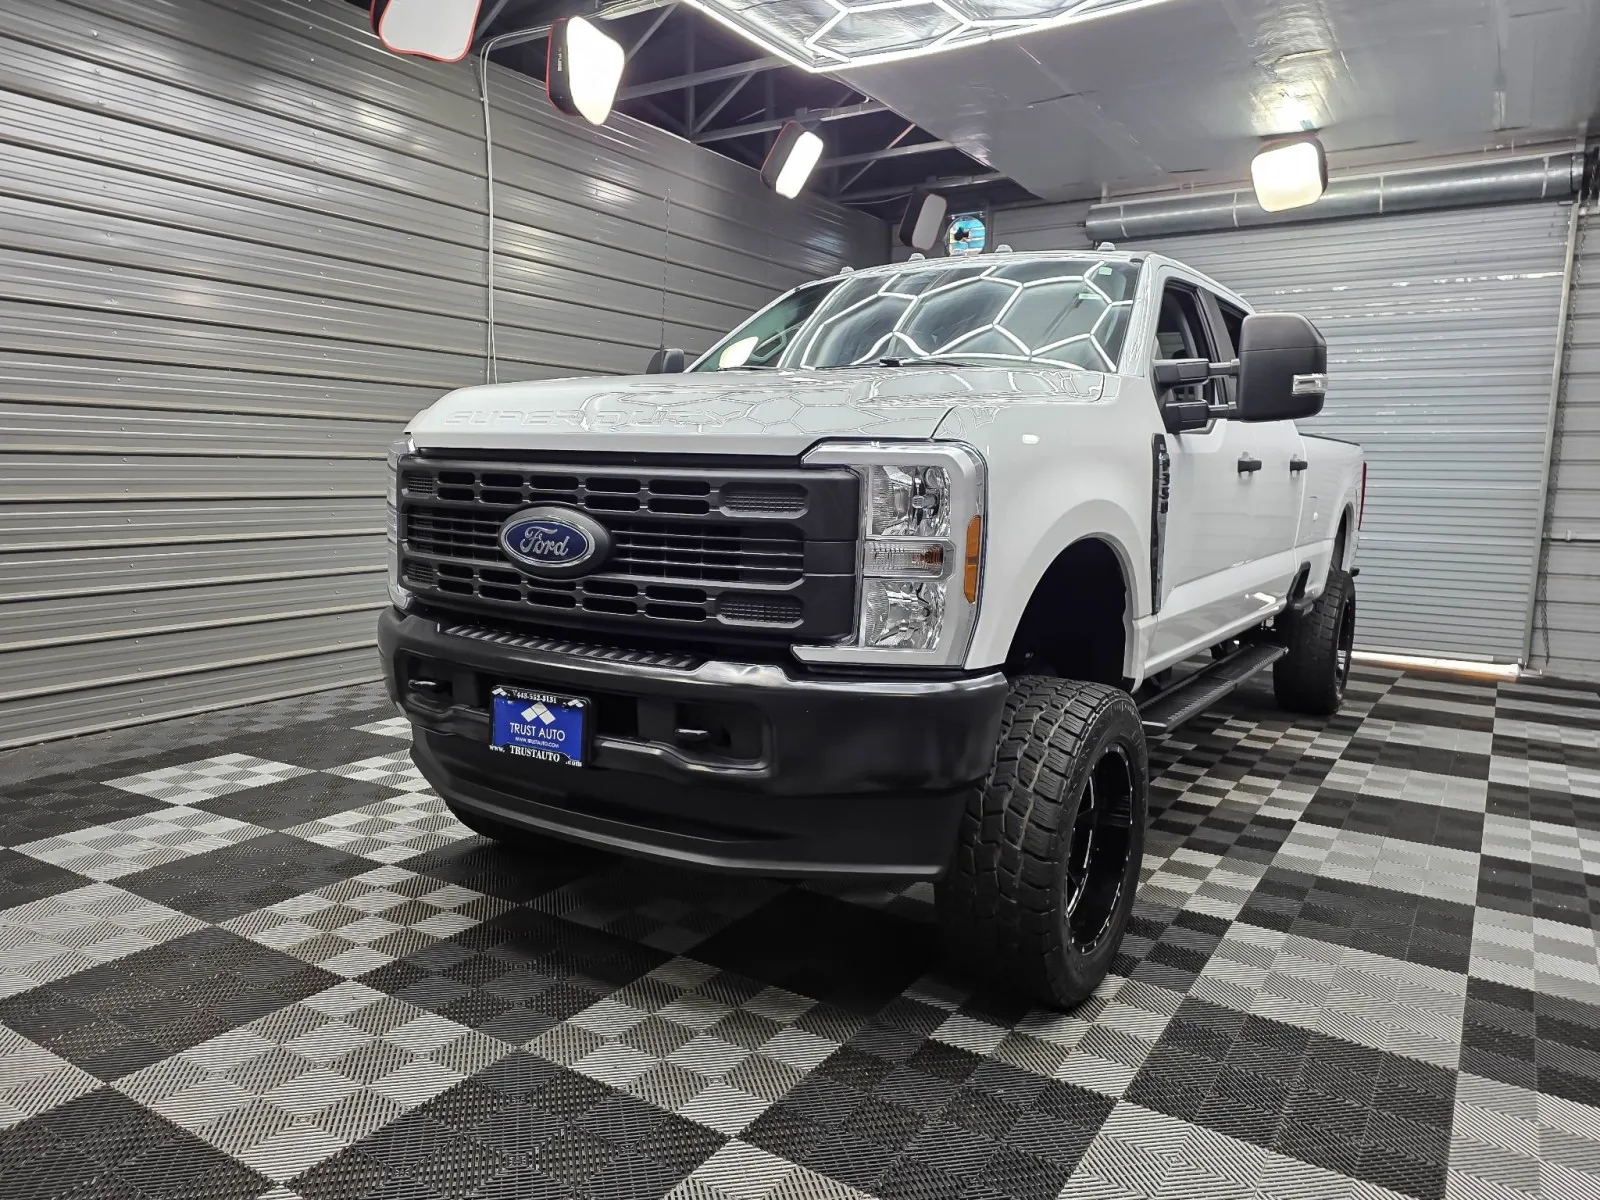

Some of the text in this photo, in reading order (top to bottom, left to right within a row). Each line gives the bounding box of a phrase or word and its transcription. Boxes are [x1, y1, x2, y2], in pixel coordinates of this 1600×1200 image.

[444, 409, 742, 427] SUPER DUTY
[520, 526, 570, 556] Ford
[509, 722, 566, 742] TRUST AUTO
[509, 745, 560, 762] TRUSTAUTO
